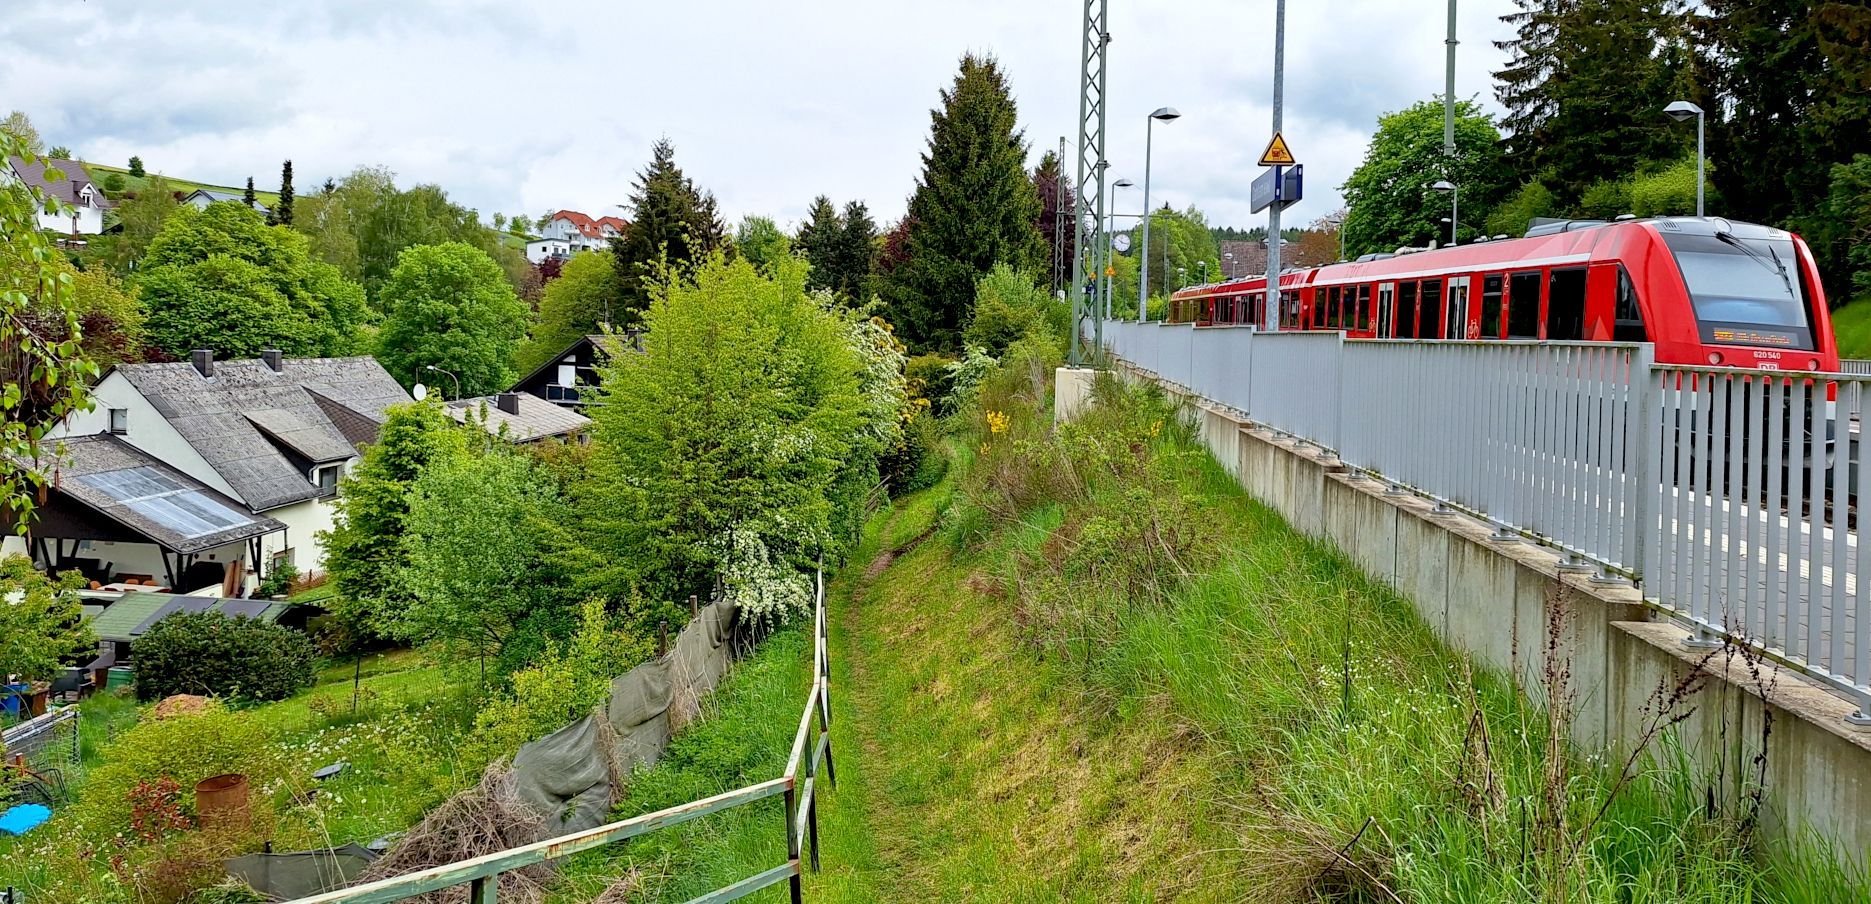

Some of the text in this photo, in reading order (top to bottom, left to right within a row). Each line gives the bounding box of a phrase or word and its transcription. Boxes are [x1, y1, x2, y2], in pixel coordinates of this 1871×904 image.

[1503, 272, 1509, 288] 2
[1753, 351, 1781, 360] 620 540
